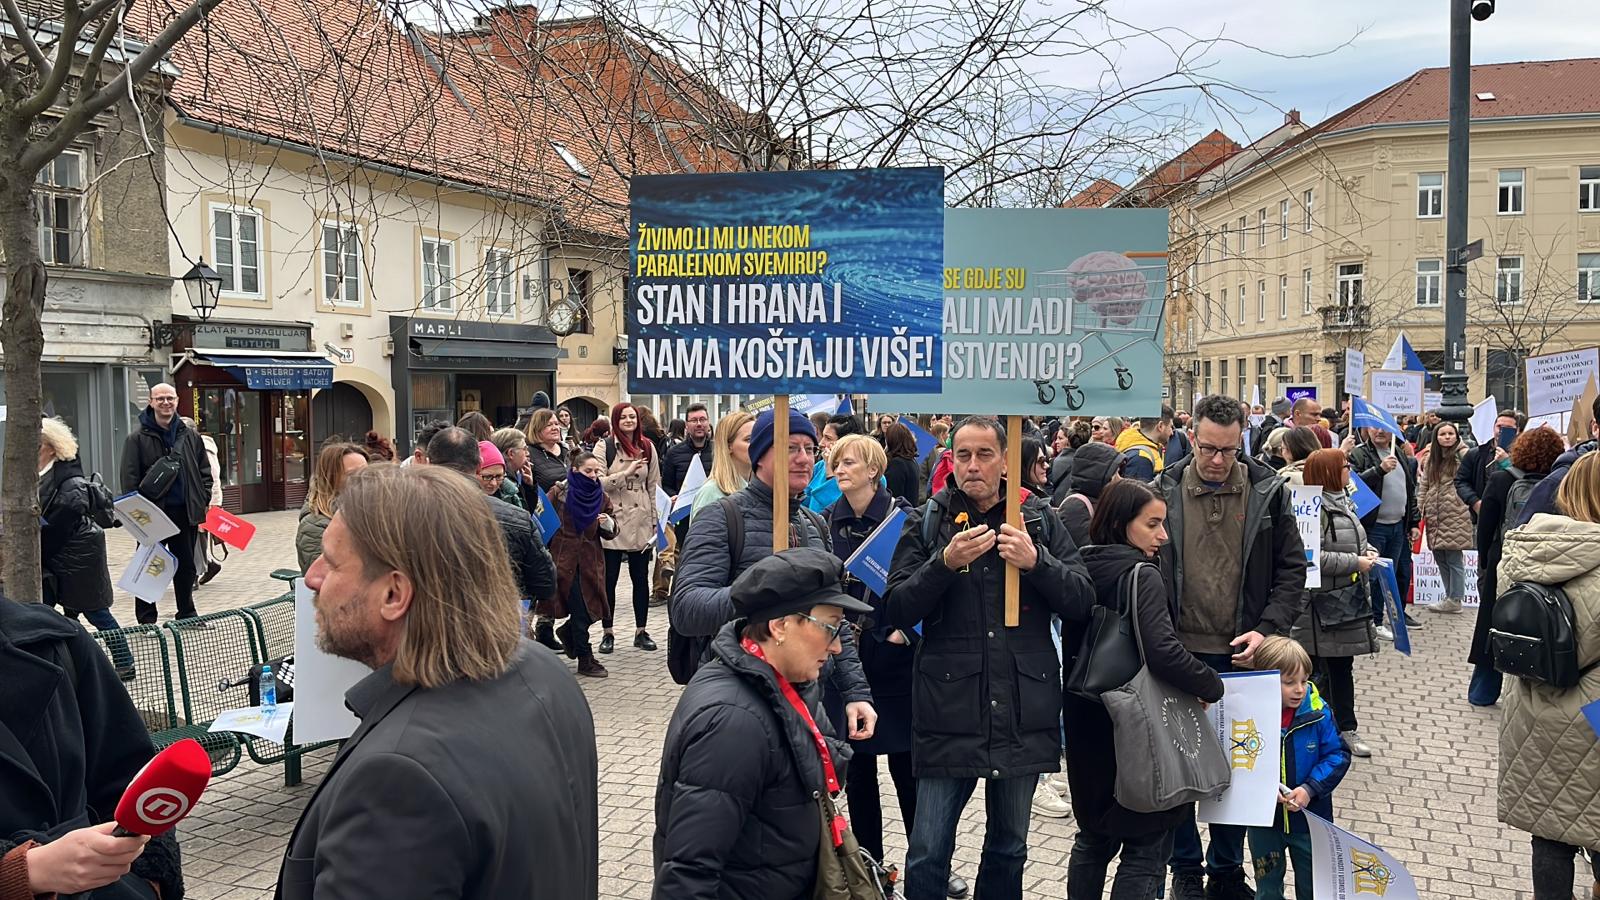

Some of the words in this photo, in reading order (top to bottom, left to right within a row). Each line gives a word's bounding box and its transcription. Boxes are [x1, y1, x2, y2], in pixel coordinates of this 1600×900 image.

[638, 222, 693, 250] ŽIVIMO
[697, 227, 709, 250] LI
[713, 226, 734, 250] MI
[738, 226, 748, 249] U
[752, 224, 810, 249] NEKOM
[637, 252, 740, 277] PARALELNOM
[744, 250, 828, 276] SVEMIRU?
[944, 268, 960, 289] SE
[964, 268, 1002, 289] GDJE
[1005, 268, 1025, 289] SU
[636, 284, 706, 324] STAN
[712, 284, 720, 324] I
[728, 282, 827, 324] HRANA
[834, 282, 842, 323] I
[988, 297, 1072, 334] MLADI
[197, 326, 237, 334] ZLATAR
[248, 328, 306, 338] DRAGULJAR
[414, 324, 462, 336] MARLI
[636, 338, 722, 379] NAMA
[728, 328, 854, 379] KOŠTAJU
[860, 326, 933, 378] VIŠE!
[942, 342, 1082, 380] STVENICI?
